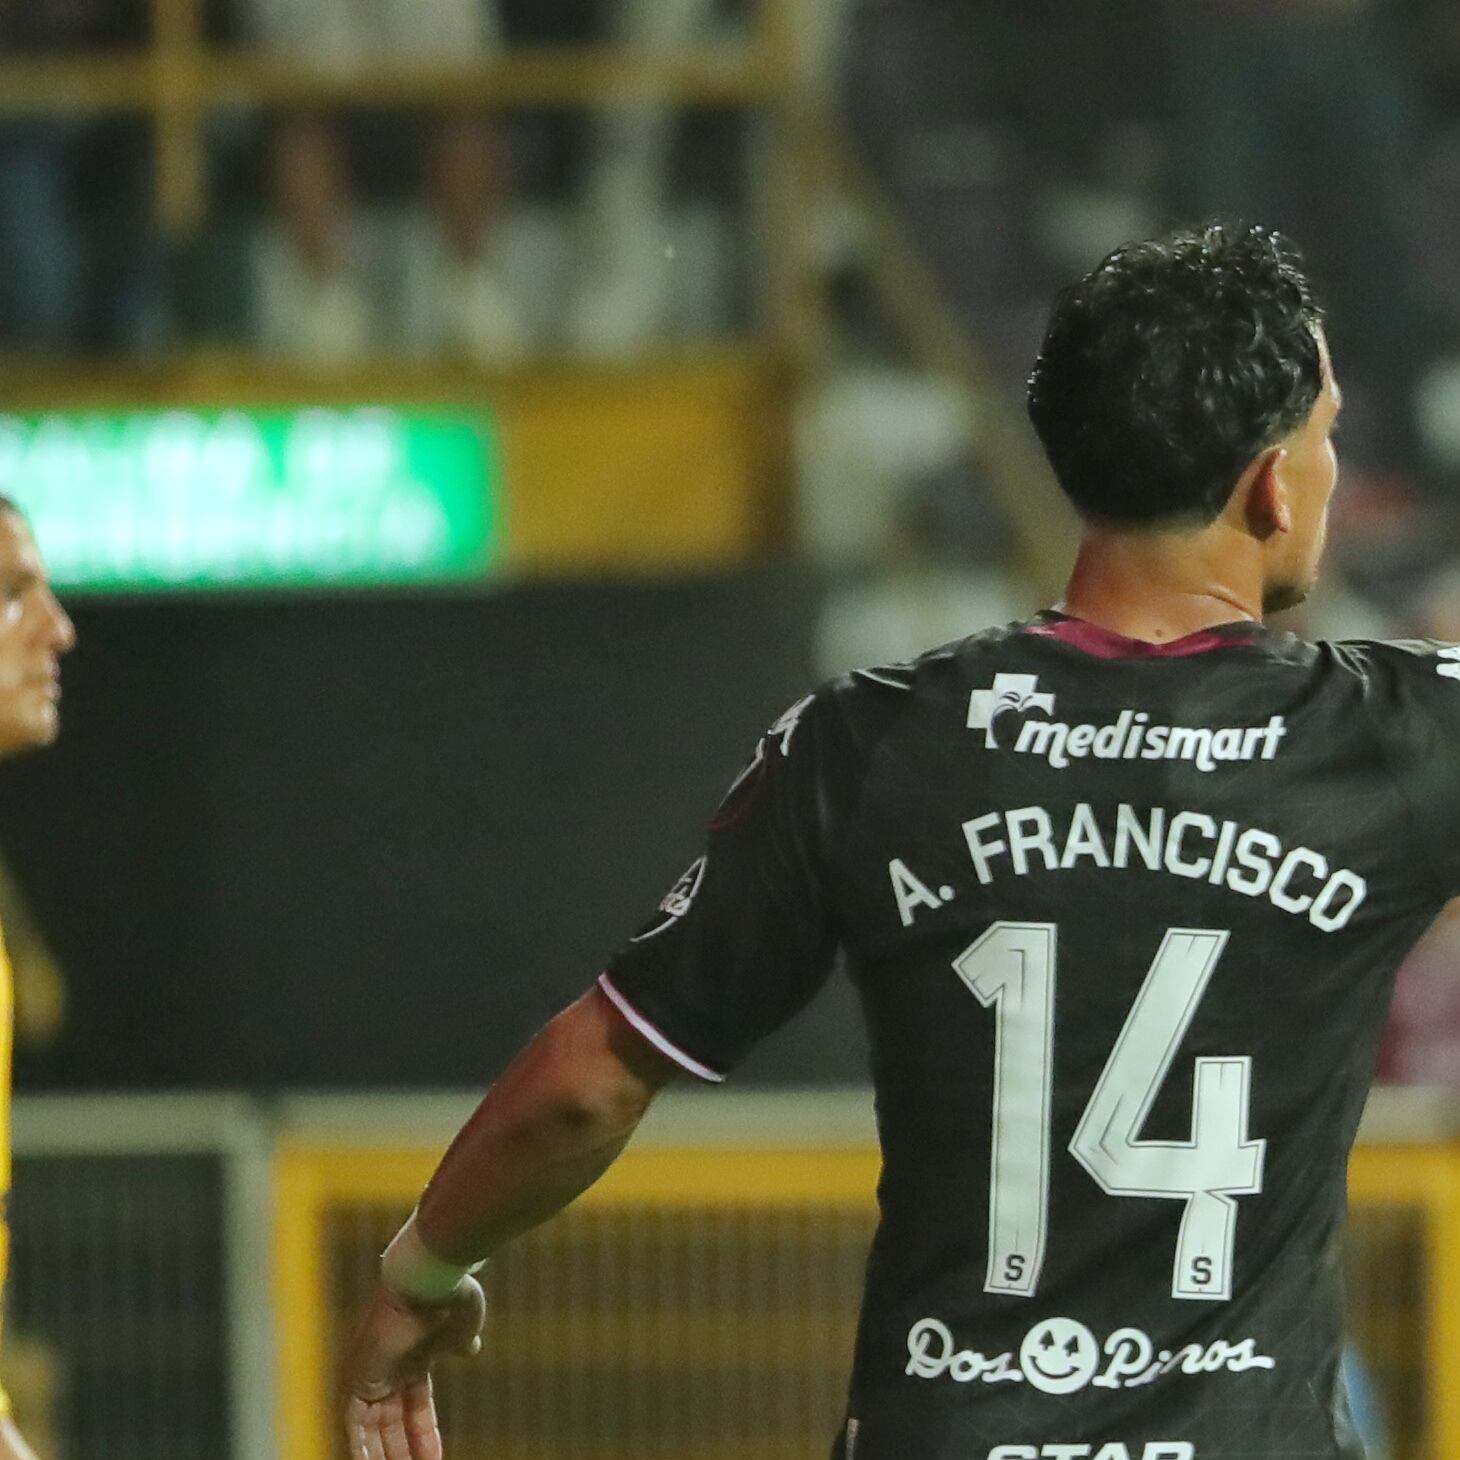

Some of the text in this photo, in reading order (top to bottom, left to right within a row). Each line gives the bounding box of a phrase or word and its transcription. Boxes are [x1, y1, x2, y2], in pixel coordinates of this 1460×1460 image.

[1013, 709, 1288, 773] medismart
[887, 802, 1368, 934] A. FRANCISCO
[951, 919, 1267, 1301] 14
[1003, 1253, 1213, 1285] S S
[905, 1316, 1025, 1383] Dos
